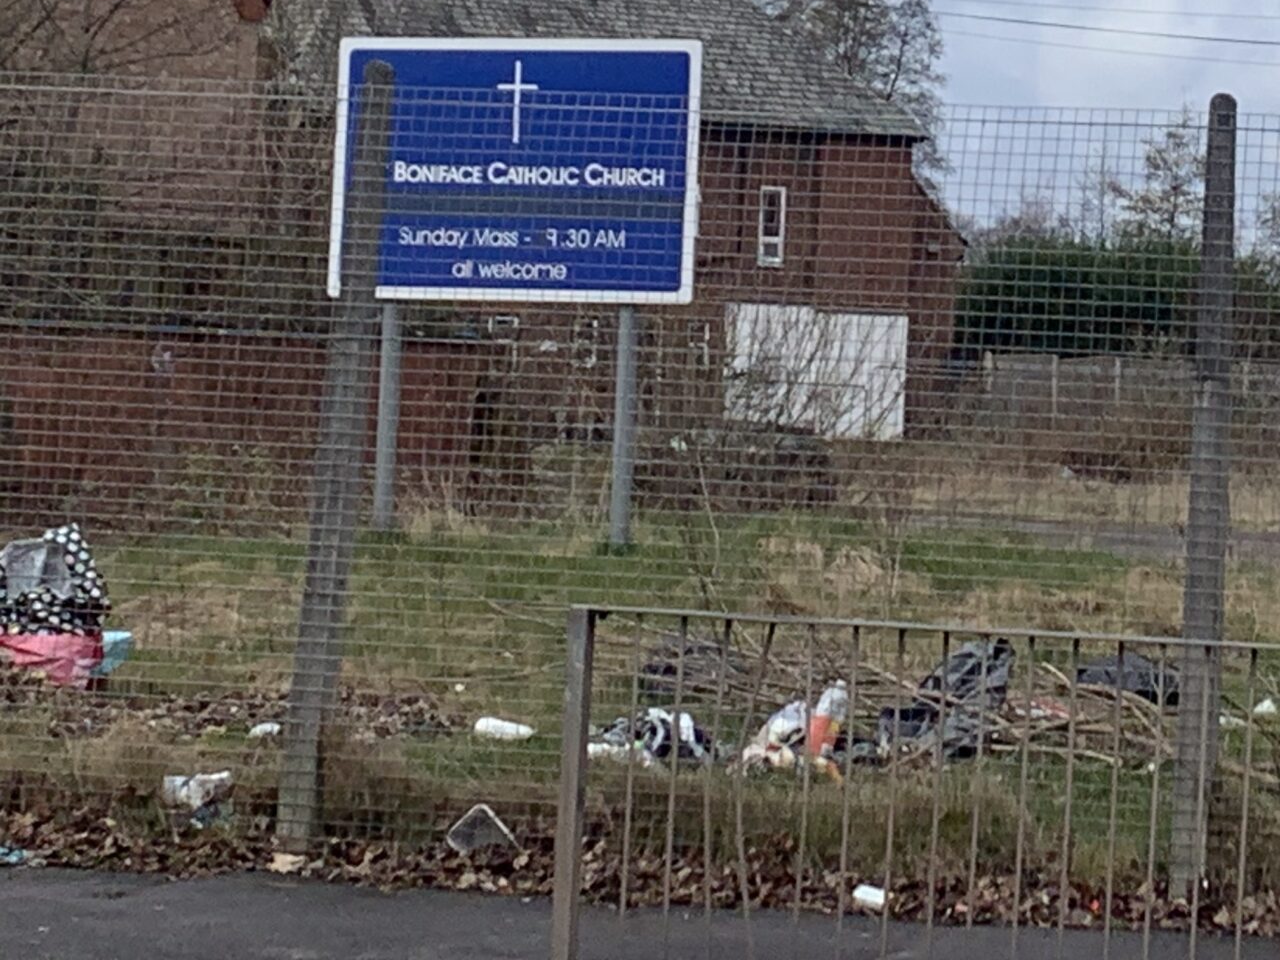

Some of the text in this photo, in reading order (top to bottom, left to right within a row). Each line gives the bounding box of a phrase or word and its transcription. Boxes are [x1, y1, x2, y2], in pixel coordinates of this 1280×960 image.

[394, 160, 665, 187] BONIFACE CATHOLIC CHURCH
[399, 226, 468, 249] Sunday
[473, 228, 519, 247] Mass
[594, 229, 626, 248] AM
[452, 260, 567, 280] all welcome
